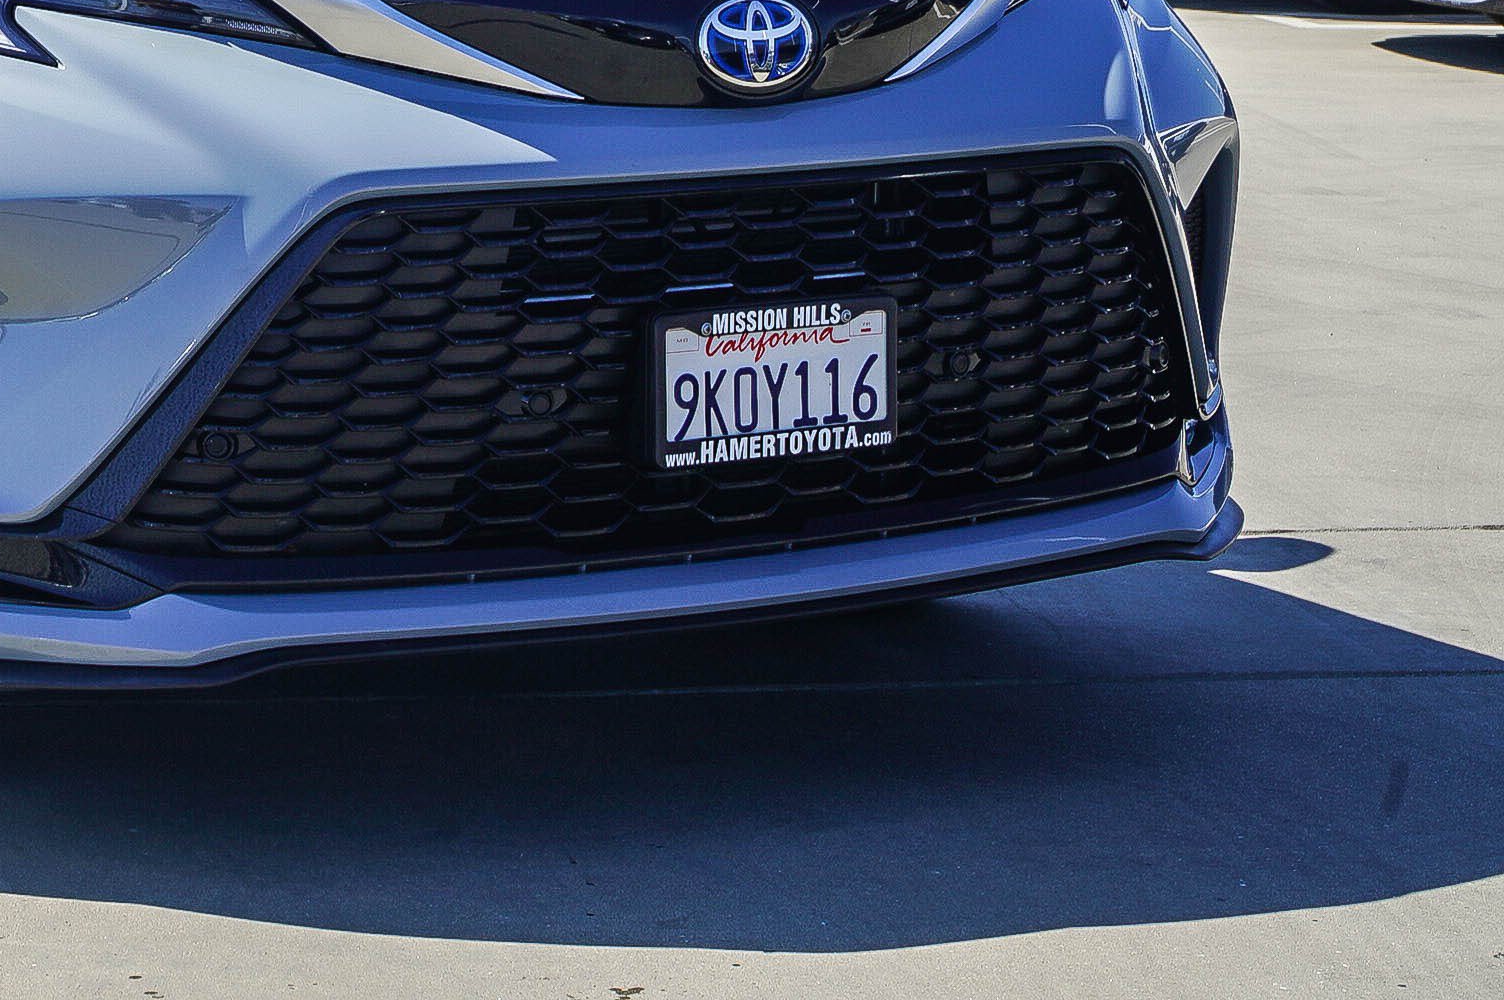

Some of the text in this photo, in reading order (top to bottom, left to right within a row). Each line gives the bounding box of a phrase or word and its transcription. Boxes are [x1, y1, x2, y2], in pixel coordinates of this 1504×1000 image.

[712, 303, 841, 335] MISSION HILLS
[705, 326, 850, 362] California
[673, 353, 879, 442] 9KOY116
[665, 425, 892, 468] www.HAMERTOYOTA.com
